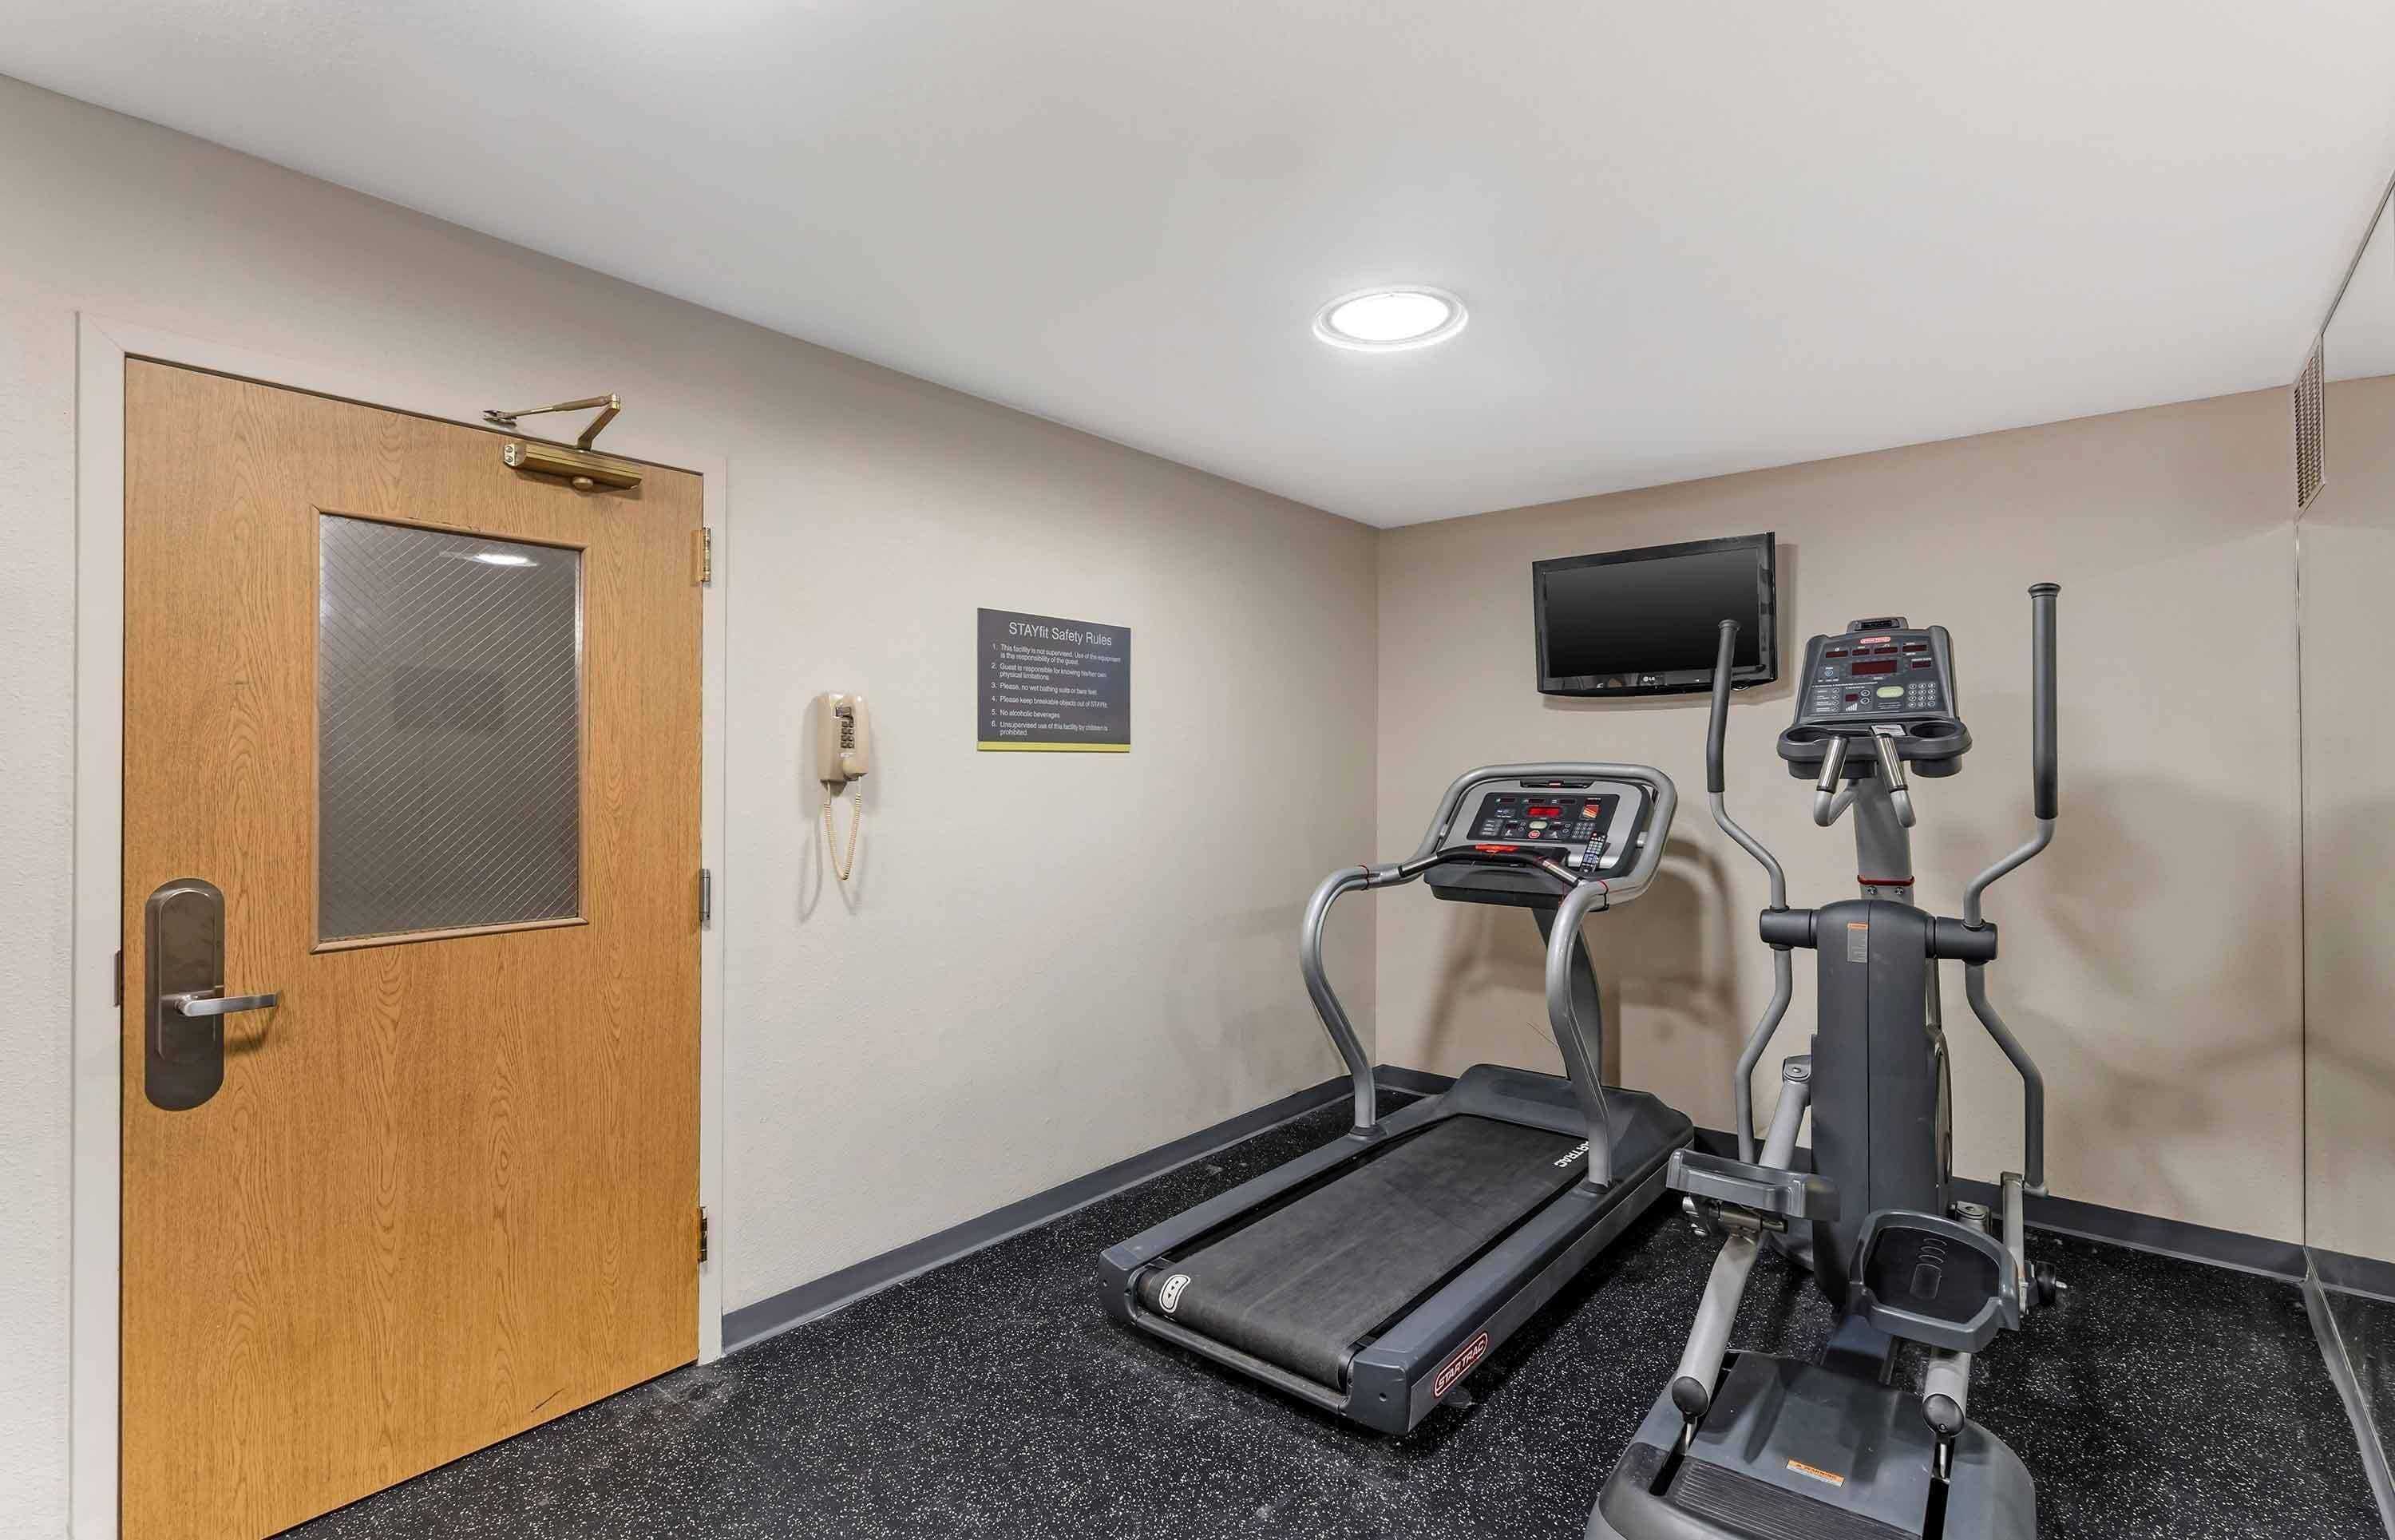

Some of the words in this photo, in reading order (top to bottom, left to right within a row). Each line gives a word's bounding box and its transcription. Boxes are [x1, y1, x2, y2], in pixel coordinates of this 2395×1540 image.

[1009, 621, 1049, 639] STAYfit
[1051, 627, 1083, 645] Safety
[1086, 631, 1112, 646] Rules
[1013, 645, 1031, 655] facility
[1016, 654, 1049, 663] responsibility
[1023, 666, 1053, 675] responsible
[1039, 685, 1058, 694] bathing
[1034, 697, 1059, 706] breakable
[1576, 1141, 1591, 1152] AR
[1554, 1150, 1585, 1168] TRAC
[1438, 1361, 1462, 1389] STAR
[1462, 1340, 1485, 1368] TRAC
